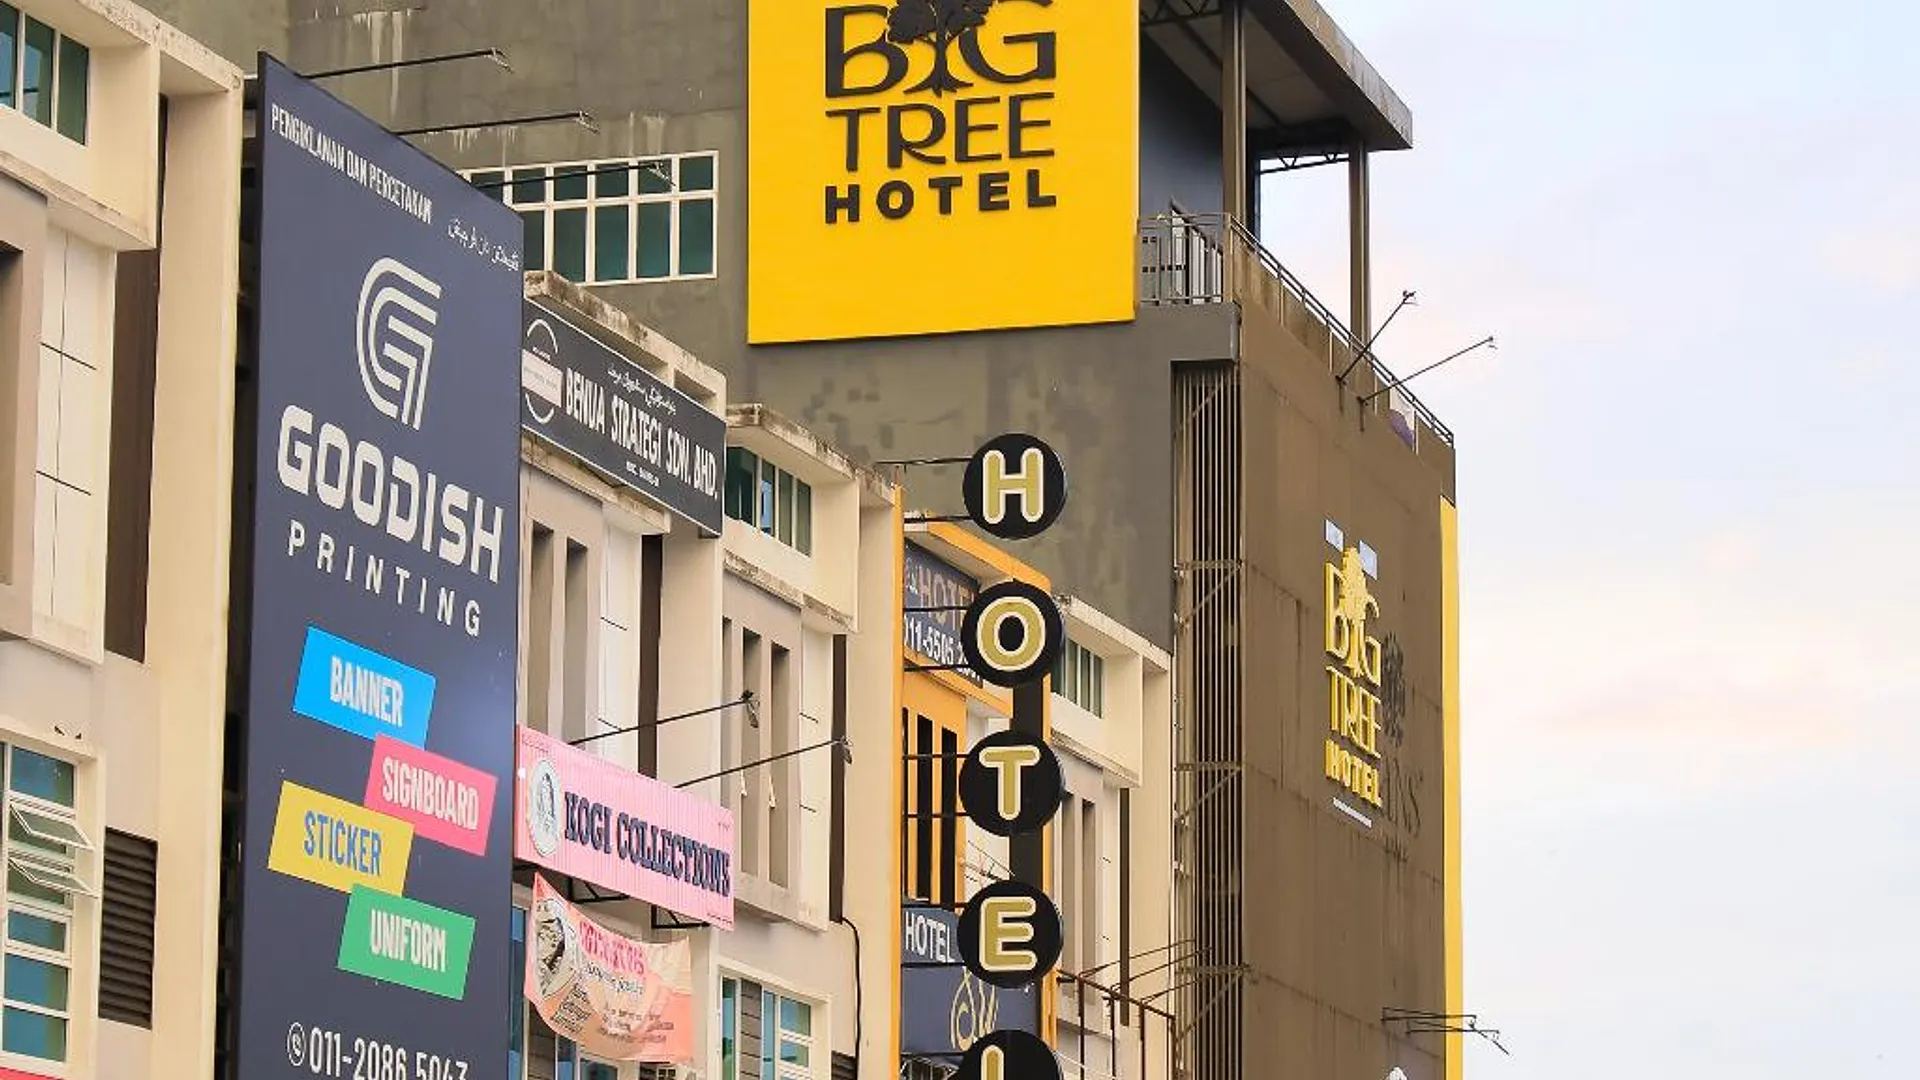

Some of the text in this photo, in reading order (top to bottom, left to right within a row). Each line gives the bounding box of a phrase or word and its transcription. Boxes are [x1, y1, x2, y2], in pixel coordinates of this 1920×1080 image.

[271, 103, 433, 225] PENGIKLANAN DAN PERCETAKAN
[825, 92, 1055, 172] TREE
[825, 169, 1057, 224] HOTEL
[565, 367, 605, 435] BENUA
[611, 394, 662, 468] STRATEGI
[666, 427, 692, 485] SDN.
[693, 444, 718, 500] BHD.
[278, 404, 504, 584] GOODISH
[288, 519, 481, 637] PRINTING
[918, 564, 975, 633] HOTE
[330, 655, 404, 727] BANNER
[1325, 665, 1381, 758] TREE
[382, 756, 480, 831] SIGNBOARD
[1325, 739, 1381, 807] HOTEL
[303, 810, 382, 876] STICKER
[565, 791, 730, 898] KOGI COLLECTIONS
[370, 908, 447, 973] UNIFORM
[905, 911, 956, 963] HOTEL
[309, 1027, 408, 1080] 011-2086
